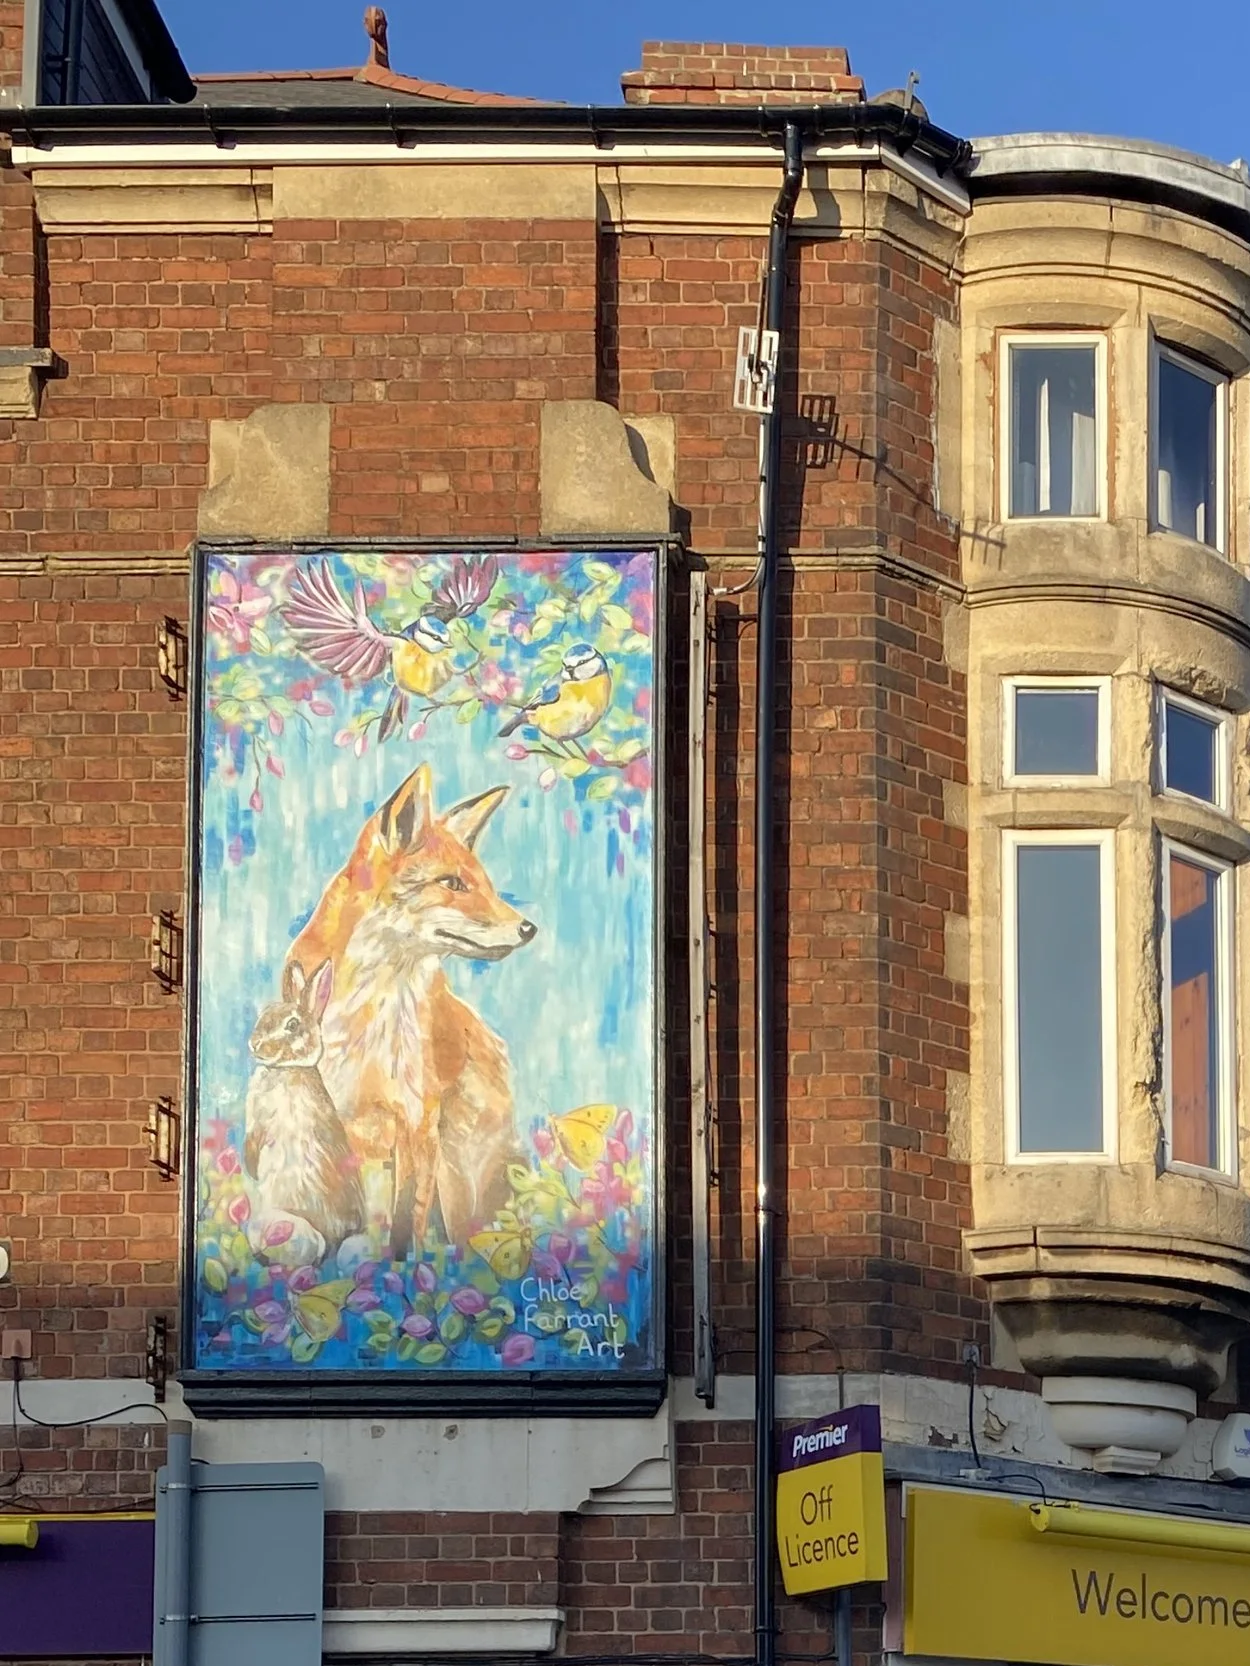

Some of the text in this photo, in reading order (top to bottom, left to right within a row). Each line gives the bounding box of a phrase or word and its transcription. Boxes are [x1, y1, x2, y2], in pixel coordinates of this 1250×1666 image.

[524, 1303, 620, 1332] Farrant
[577, 1331, 625, 1359] Art
[792, 1423, 848, 1458] Premier
[800, 1484, 834, 1526] Off
[785, 1531, 859, 1568] Licence
